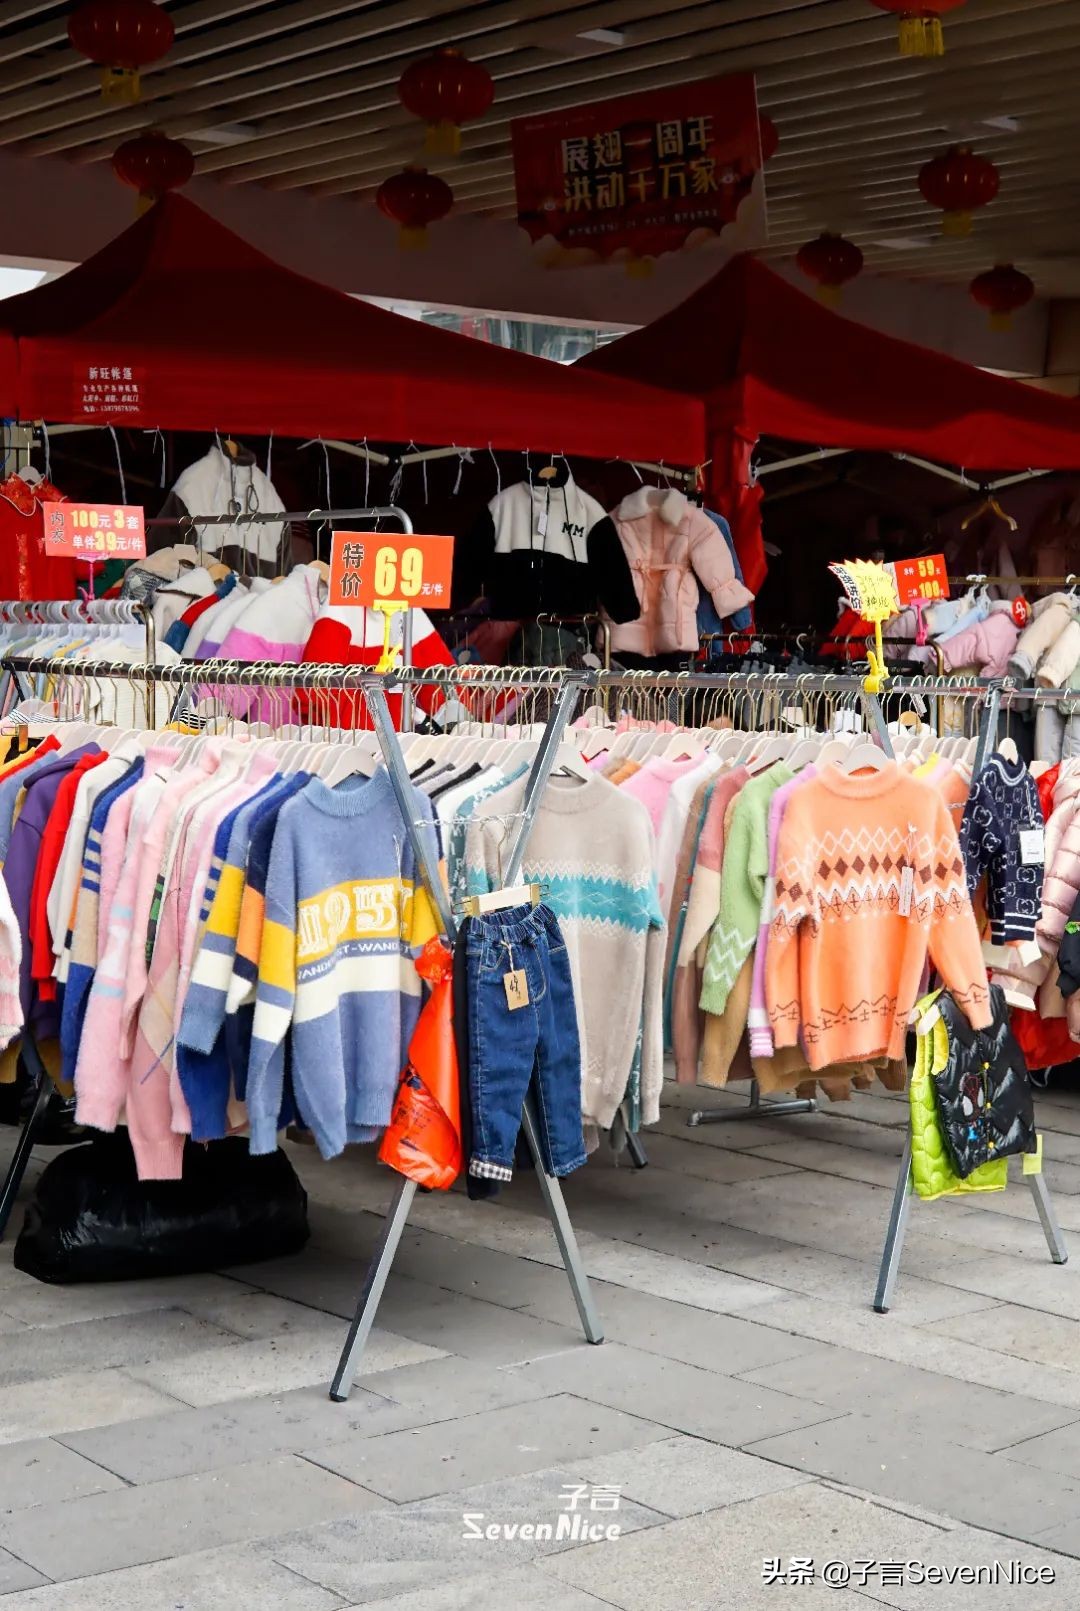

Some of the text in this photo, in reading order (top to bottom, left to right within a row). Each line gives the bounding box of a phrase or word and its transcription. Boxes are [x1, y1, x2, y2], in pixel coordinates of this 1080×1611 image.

[561, 115, 715, 173] 展翅一周年
[563, 157, 720, 213] 洪动千万家
[51, 511, 66, 544] 内衣
[340, 542, 364, 598] 特价
